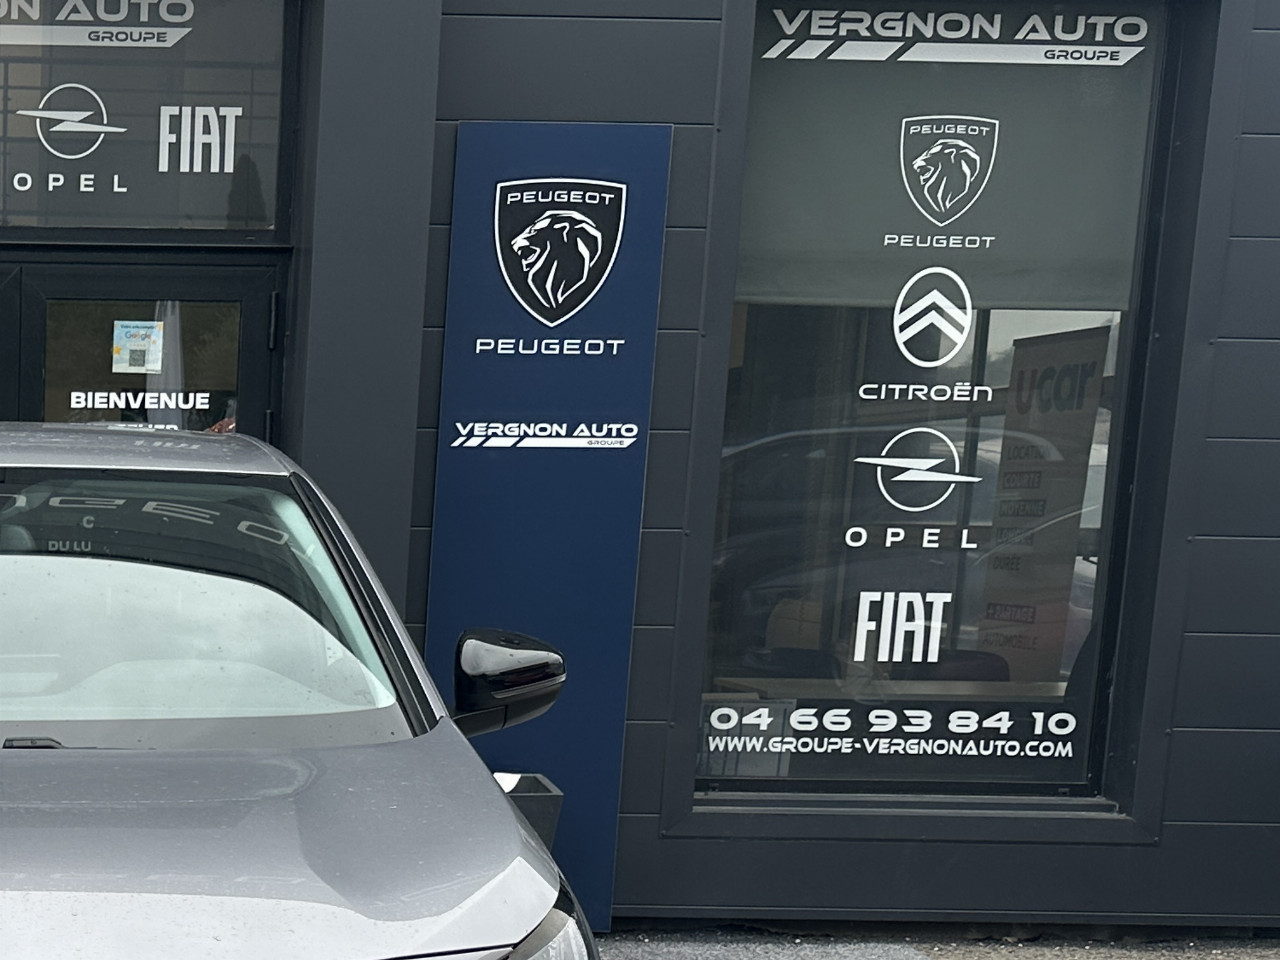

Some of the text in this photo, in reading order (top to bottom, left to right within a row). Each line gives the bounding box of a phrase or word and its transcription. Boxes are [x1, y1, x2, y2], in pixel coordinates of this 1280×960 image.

[55, 0, 195, 23] AUTO
[772, 9, 1149, 42] VERGNON AUTO
[87, 30, 168, 43] GROUPE
[1043, 49, 1121, 61] GROUPE
[158, 105, 243, 173] FIAT
[909, 124, 991, 136] PEUGEOT
[12, 173, 128, 193] OPEL
[507, 190, 615, 205] PEUGEOT
[883, 234, 996, 249] PEUGEOT
[476, 338, 626, 355] PEUGEOT
[70, 391, 210, 410] BIENVENUE
[455, 422, 639, 437] VERGNON AUTO
[844, 527, 978, 548] OPEL
[853, 591, 953, 663] FIAT
[709, 707, 1077, 735] 04 66 93 84 10
[708, 735, 1074, 758] WWW.GROUPE-VERGNONAUTO.COM
